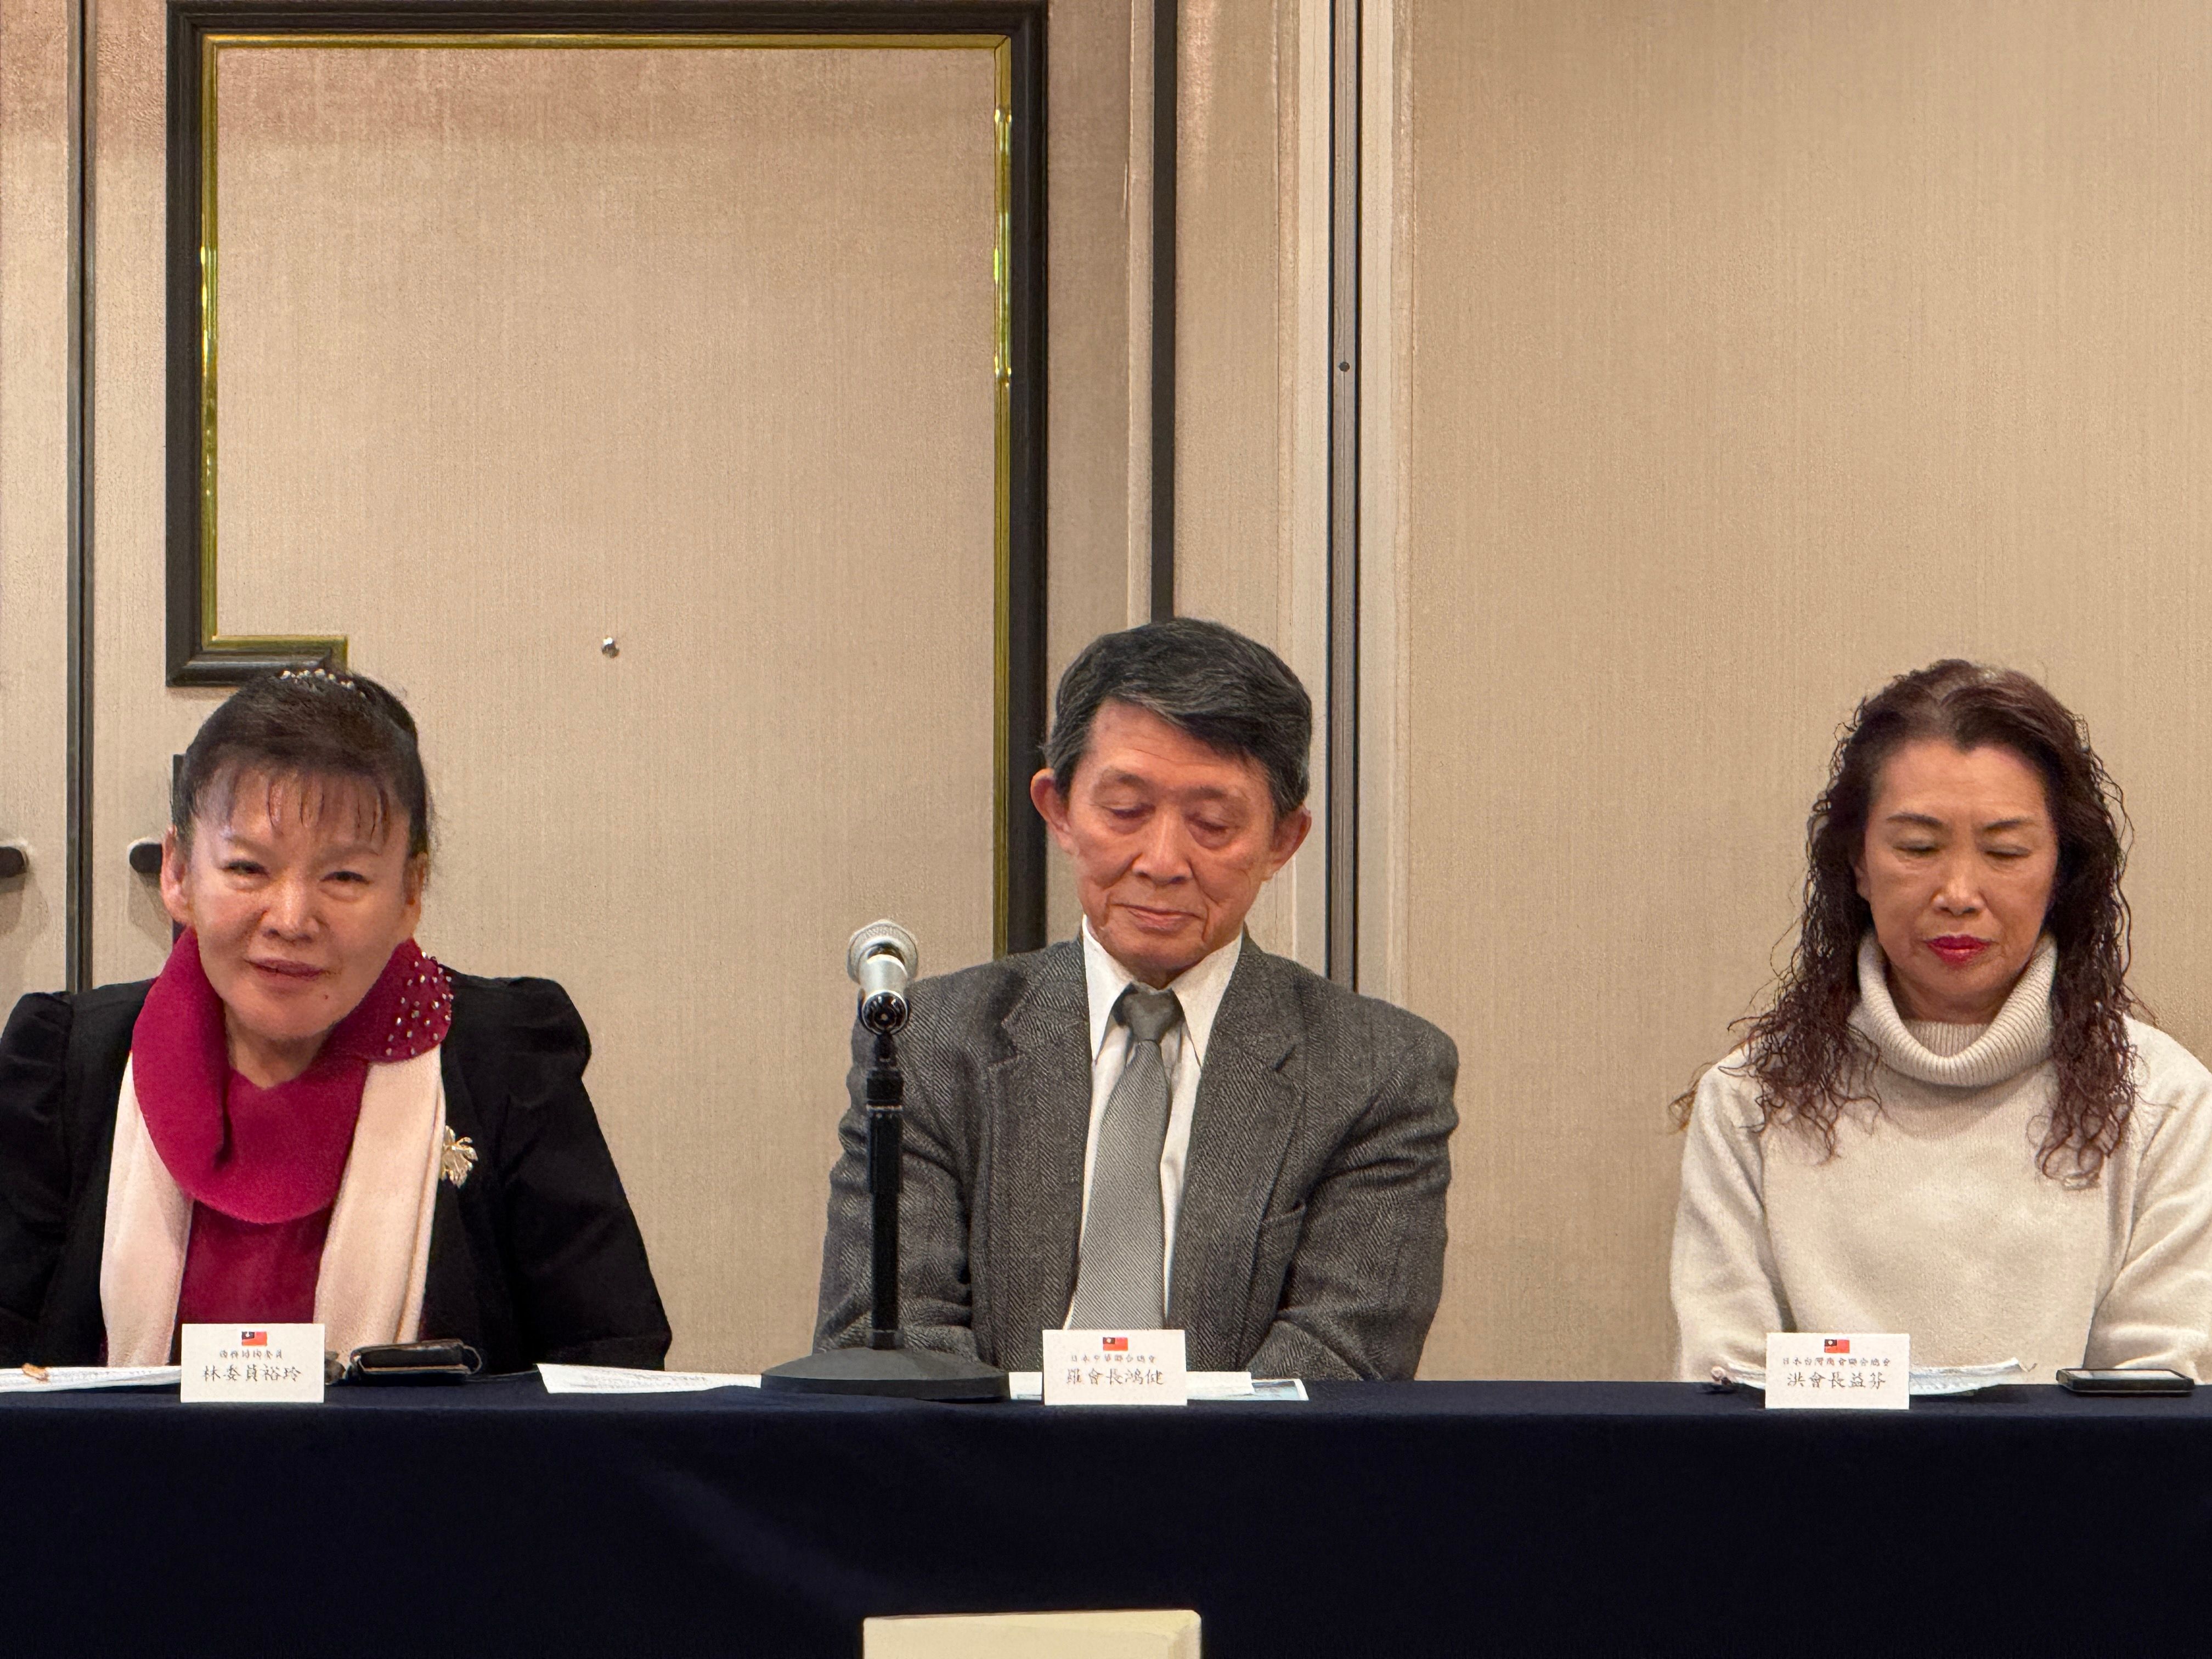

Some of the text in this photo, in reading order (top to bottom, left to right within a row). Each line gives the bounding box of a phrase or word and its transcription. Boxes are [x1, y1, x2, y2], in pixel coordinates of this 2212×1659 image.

[202, 1364, 301, 1382] 林委員裕玲
